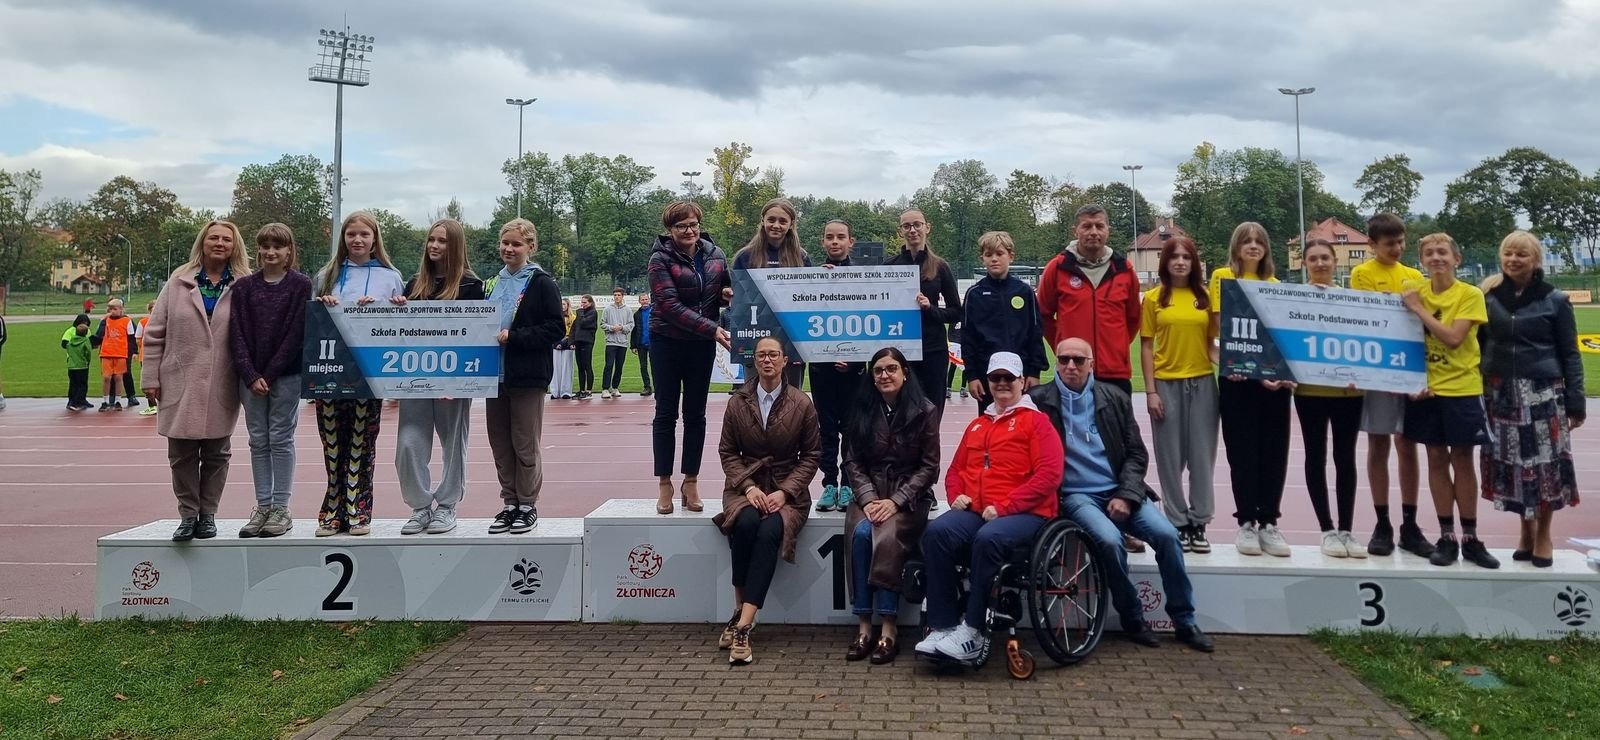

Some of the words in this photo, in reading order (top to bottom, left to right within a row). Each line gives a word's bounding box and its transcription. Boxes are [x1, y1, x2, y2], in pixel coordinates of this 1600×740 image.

[864, 271, 882, 279] SZKÓŁ
[792, 293, 817, 302] Szkoła
[820, 293, 867, 301] Podstawowa
[880, 292, 890, 300] 11
[1327, 293, 1361, 303] SPORTOWE
[410, 306, 442, 314] SPORTOWE
[444, 305, 462, 314] SZKÓŁ
[750, 305, 758, 325] I
[807, 314, 882, 337] 3000
[888, 321, 903, 336] zł
[1288, 311, 1316, 321] Szkoła
[1318, 314, 1369, 326] Podstawowa
[1372, 320, 1380, 328] nr
[1383, 319, 1389, 328] 7
[370, 328, 396, 337] Szkoła
[399, 328, 448, 336] Podstawowa
[461, 328, 467, 336] 6
[737, 328, 771, 339] miejsce
[1231, 317, 1258, 340] III
[319, 340, 336, 360] II
[1226, 341, 1263, 354] miejsce
[1303, 335, 1383, 364] 1000
[1390, 351, 1406, 367] zł
[308, 363, 344, 375] miejsce
[381, 350, 458, 373] 2000
[464, 358, 480, 372] zł
[817, 534, 846, 610] 1
[322, 552, 354, 611] 2
[616, 588, 676, 598] ZŁOTNICZA
[121, 597, 170, 606] ZŁOTNICZA
[1359, 582, 1385, 627] 3
